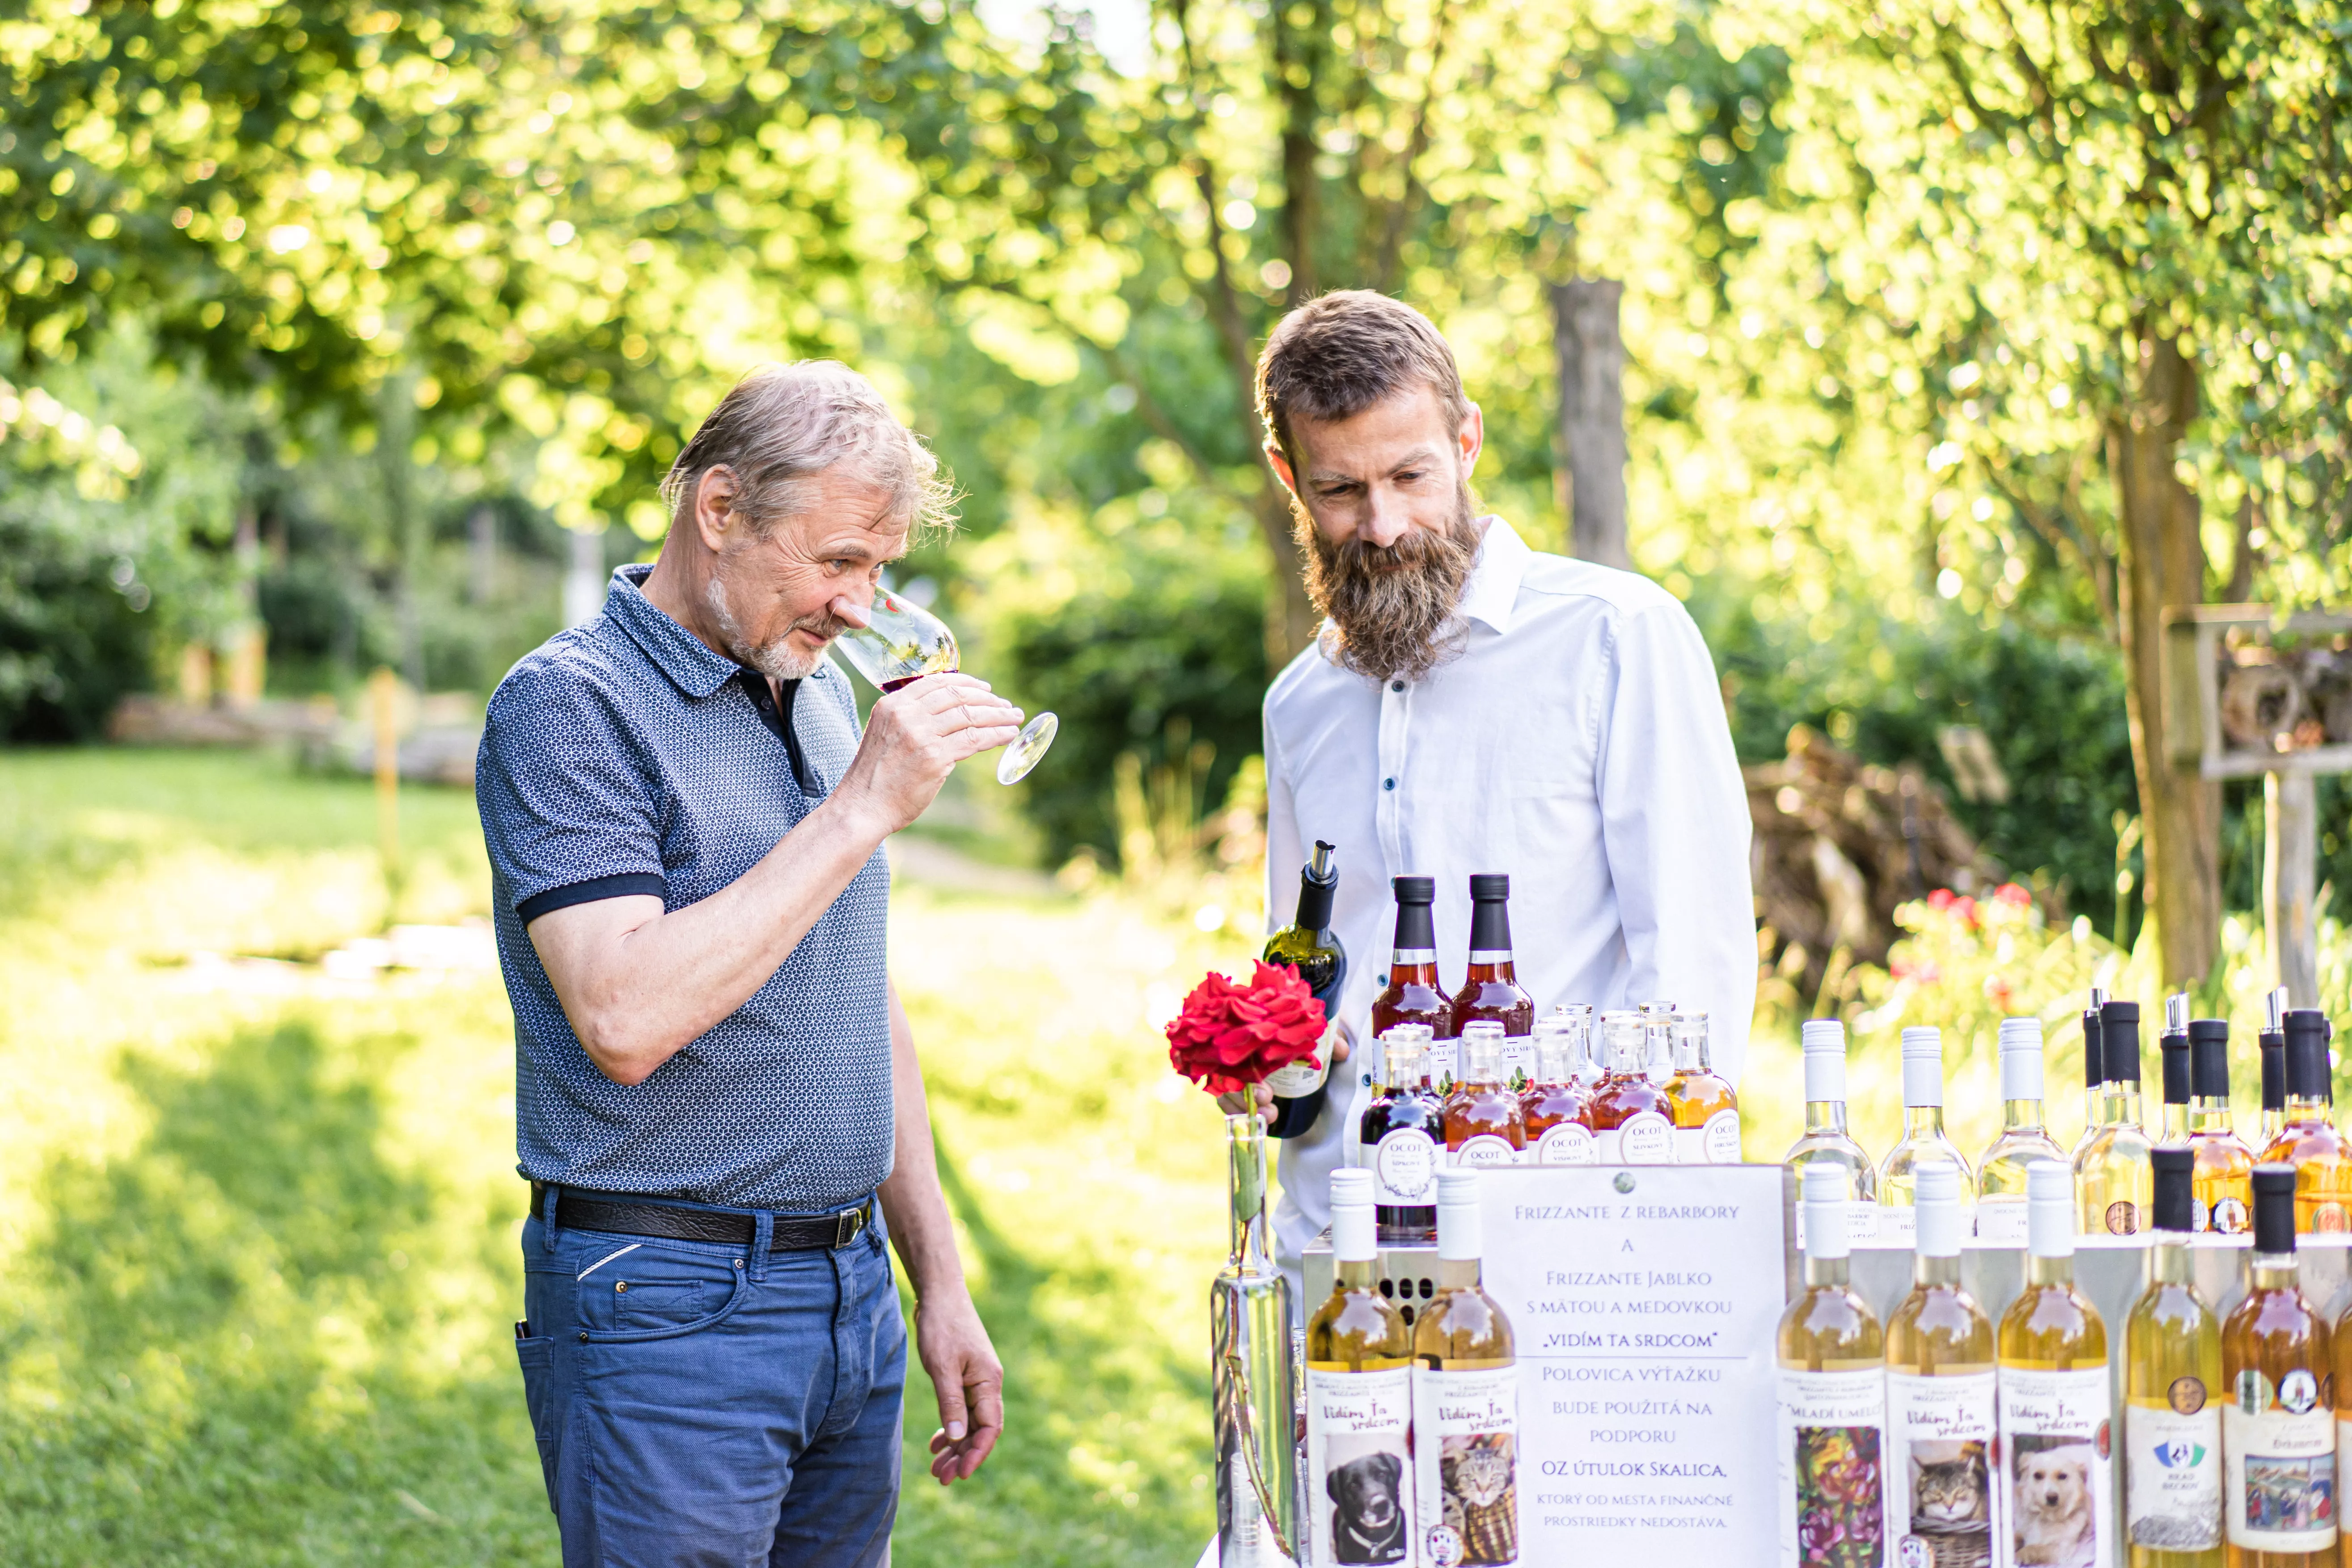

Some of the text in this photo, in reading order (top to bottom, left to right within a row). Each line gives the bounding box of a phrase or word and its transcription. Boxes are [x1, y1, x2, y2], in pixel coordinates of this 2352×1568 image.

[1633, 1126, 1662, 1136] OCOT
[1716, 1124, 1736, 1134] OCOT
[1552, 1138, 1581, 1147] OCOT
[1515, 1205, 1739, 1219] FRIZZANTE Z REBARBORY
[1621, 1239, 1633, 1251] A
[1546, 1271, 1712, 1288] FRIZZANTE JABLKO
[1527, 1301, 1535, 1313] S
[1611, 1301, 1622, 1313] A
[1628, 1301, 1732, 1314] MEDOVKOU
[1543, 1365, 1721, 1382] POLOVICA VÝŤAŽKU
[1553, 1399, 1713, 1415] BUDE POUŽITÁ NA
[1590, 1430, 1676, 1443] PODPORU
[1542, 1461, 1568, 1476] OZ
[1574, 1460, 1645, 1476] ÚTULOK
[1536, 1492, 1734, 1506] KTORÝ OD MESTA FINANČNÉ
[1544, 1516, 1637, 1528] PROSTRIEDKY
